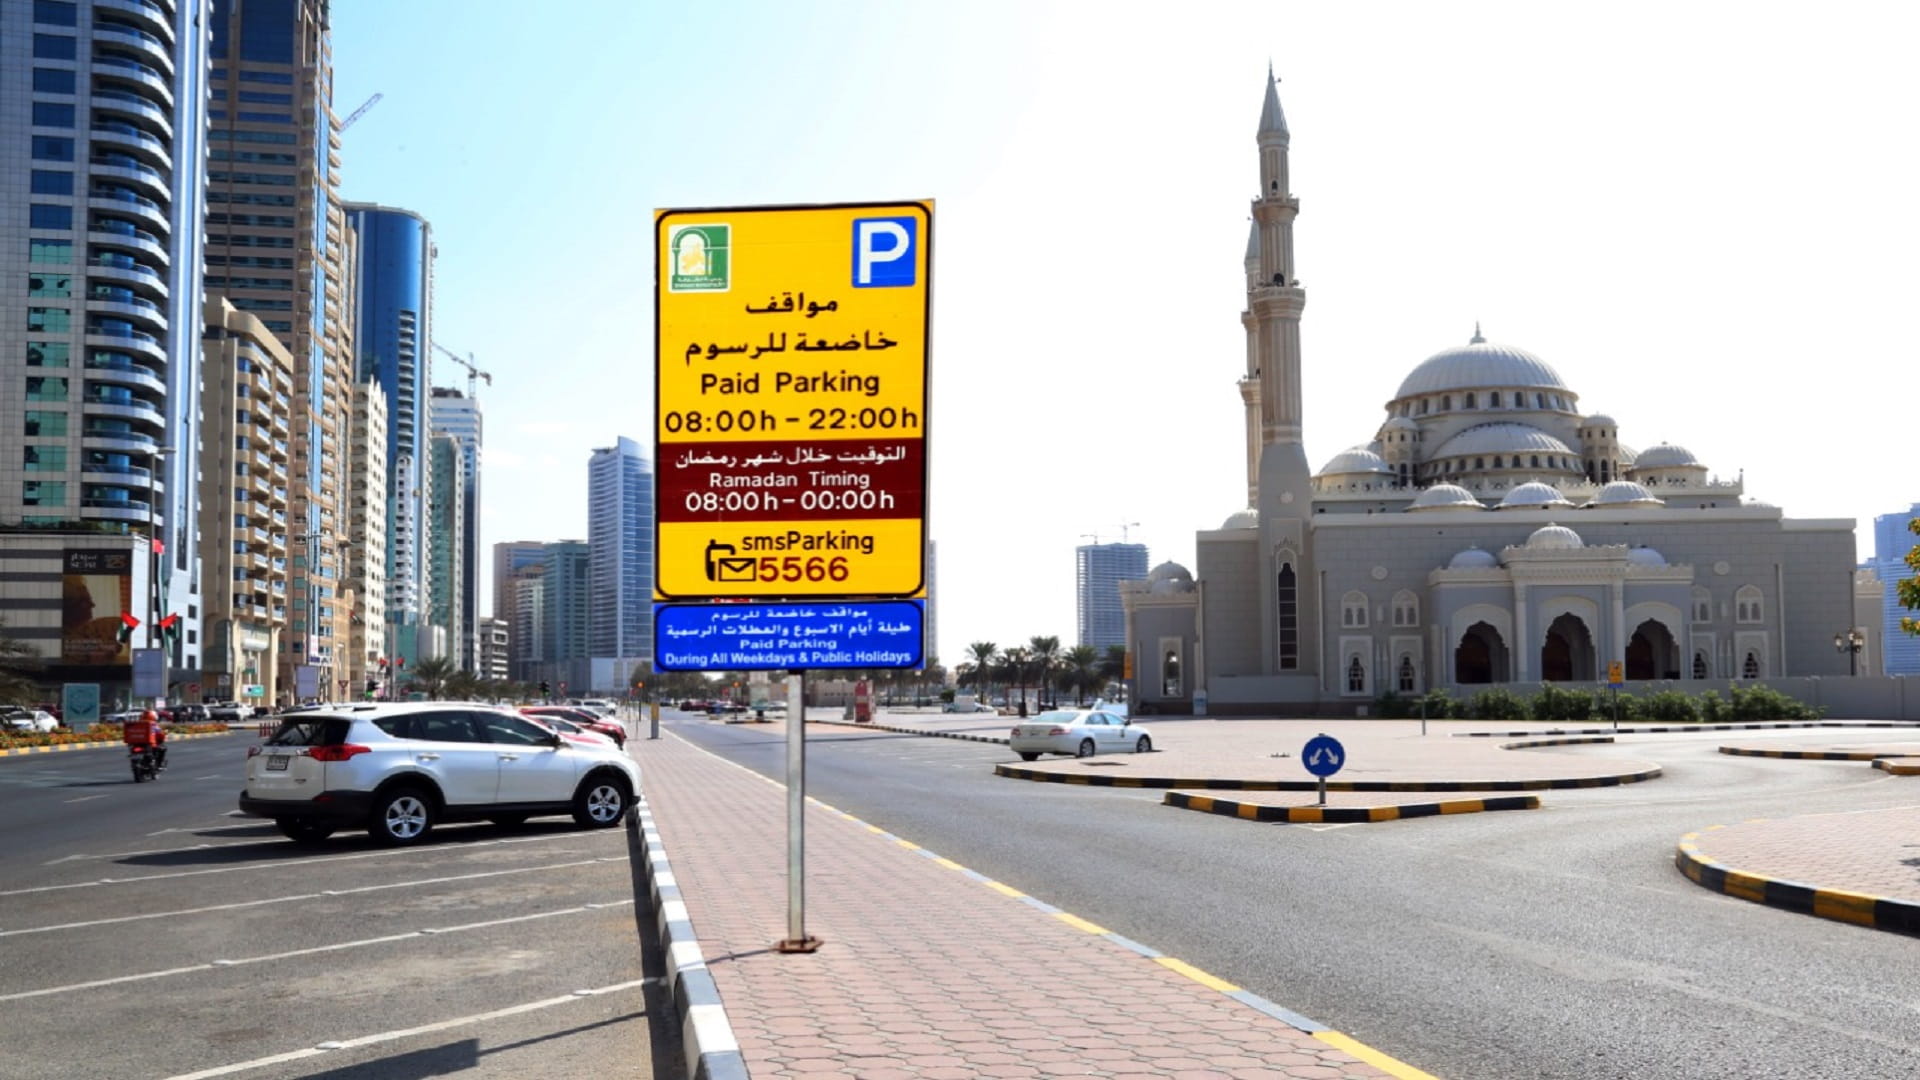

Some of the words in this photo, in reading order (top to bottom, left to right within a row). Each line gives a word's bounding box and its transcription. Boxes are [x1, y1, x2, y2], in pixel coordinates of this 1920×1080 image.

[858, 221, 910, 284] P
[745, 292, 838, 318] مواقف
[685, 332, 787, 366] للرسوم
[794, 330, 898, 351] خاضعة
[701, 372, 760, 394] Paid
[775, 369, 880, 397] Parking
[665, 409, 776, 433] 08:00h
[808, 406, 918, 430] 22:00h
[675, 449, 737, 469] رمضان
[740, 450, 783, 468] شهر
[786, 446, 832, 465] خلال
[836, 445, 906, 465] التوقيت
[709, 471, 798, 488] Ramadan
[808, 470, 870, 489] Timing
[741, 530, 874, 554] smsParking
[758, 556, 849, 582] 5566
[711, 610, 760, 622] للرسوم
[766, 608, 816, 618] خاضعة
[822, 606, 868, 618] مواقف
[666, 624, 717, 639] الرسمية
[848, 618, 872, 639] أيام
[877, 621, 911, 636] طيلة
[740, 639, 774, 650] Paid
[778, 639, 837, 650] Parking
[665, 653, 708, 667] During
[710, 652, 728, 664] All
[731, 652, 795, 666] Weekdays
[798, 651, 808, 663] &
[812, 651, 852, 663] Public
[855, 650, 912, 665] Holidays
